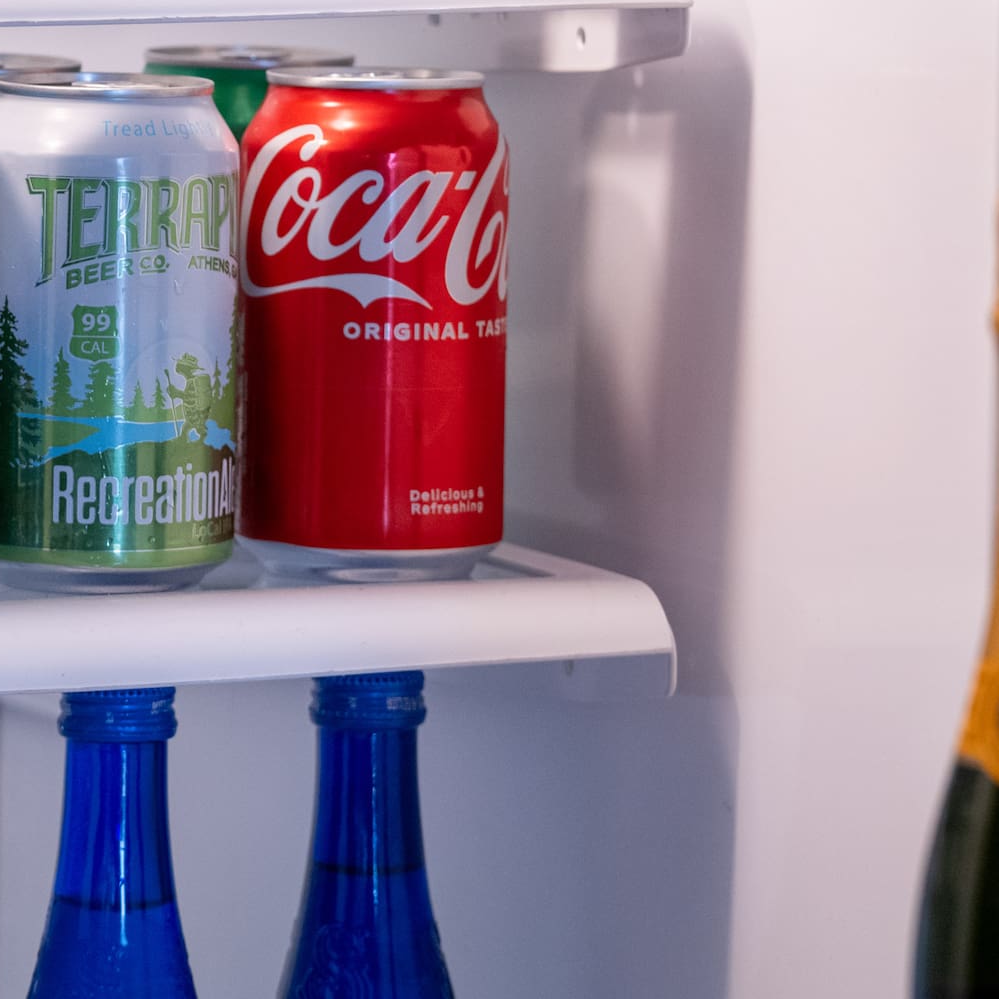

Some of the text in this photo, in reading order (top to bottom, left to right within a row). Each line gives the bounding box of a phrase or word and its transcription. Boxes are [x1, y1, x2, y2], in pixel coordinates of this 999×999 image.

[104, 119, 157, 137] Tread
[66, 257, 134, 289] BEER
[187, 255, 231, 279] ATHENS,
[81, 313, 111, 331] 99
[343, 320, 470, 342] ORIGINAL
[80, 339, 109, 354] CAL
[409, 485, 485, 502] Delicious &
[410, 499, 484, 516] Refreshing
